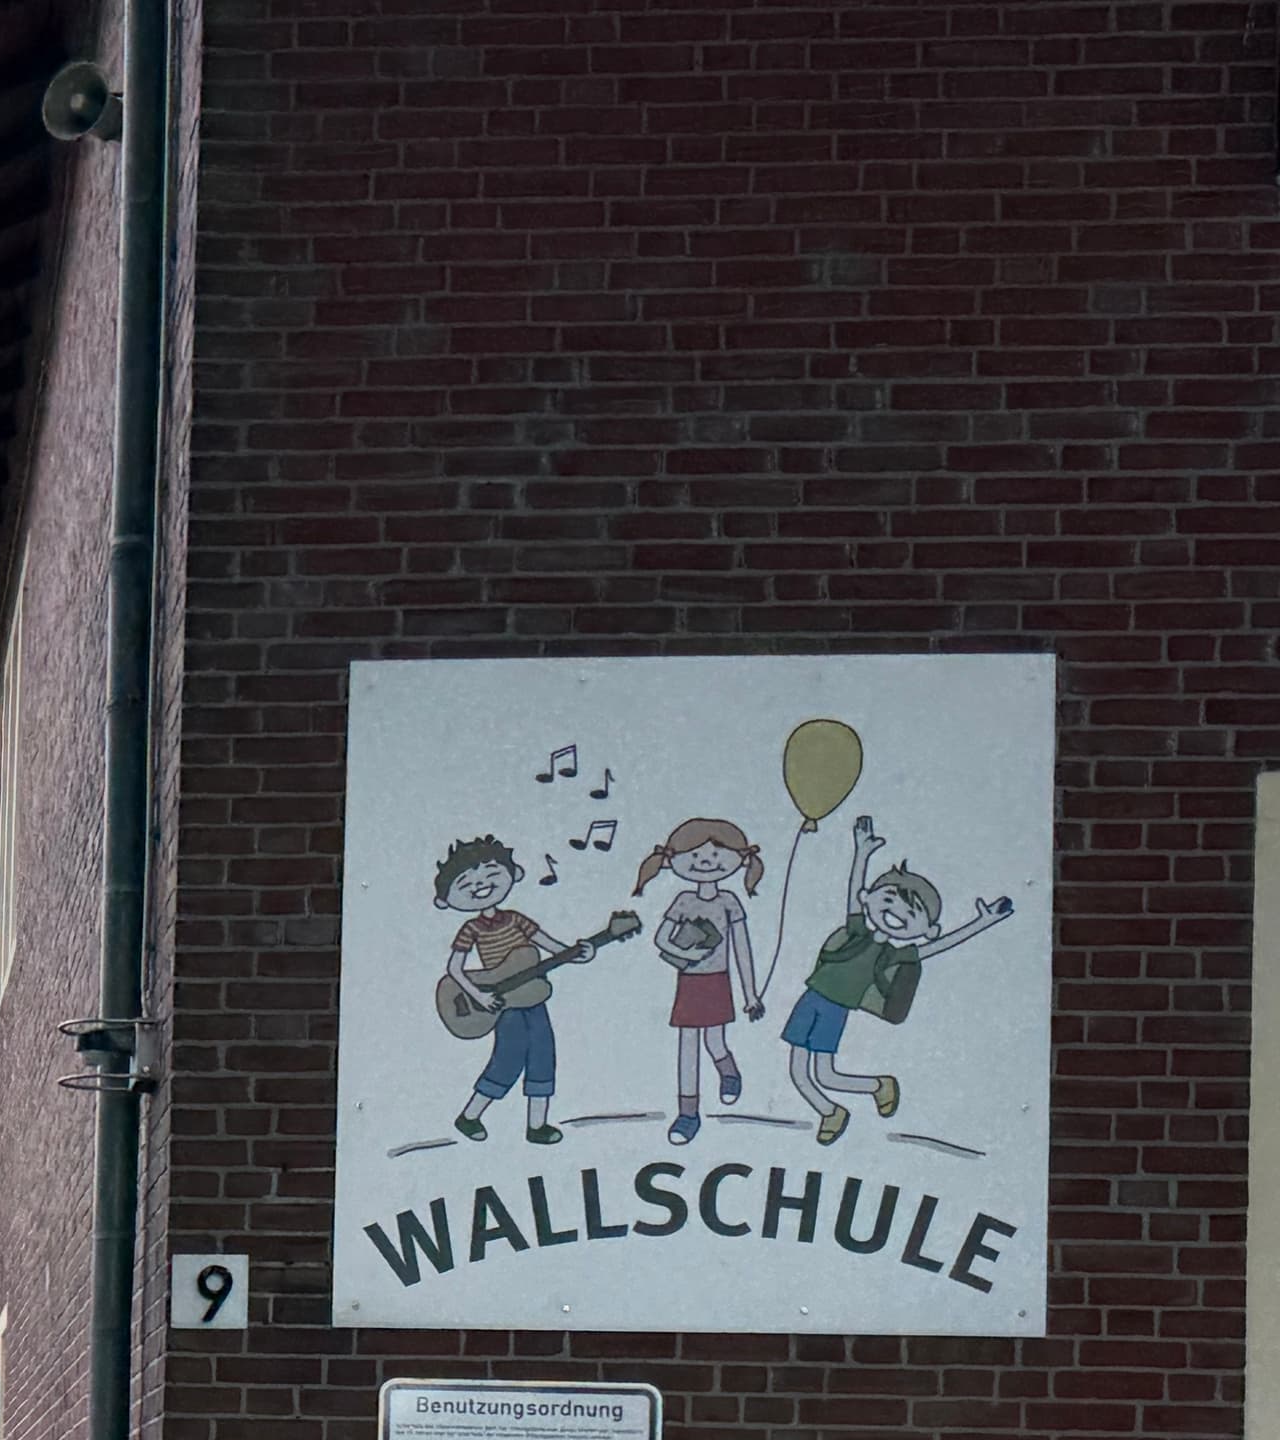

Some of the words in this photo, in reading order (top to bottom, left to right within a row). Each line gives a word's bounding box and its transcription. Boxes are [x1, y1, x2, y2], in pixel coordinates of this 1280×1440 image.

[364, 1163, 1017, 1294] WALLSCHULE
[197, 1265, 233, 1323] 9
[416, 1396, 623, 1421] Benutzungsordnung
